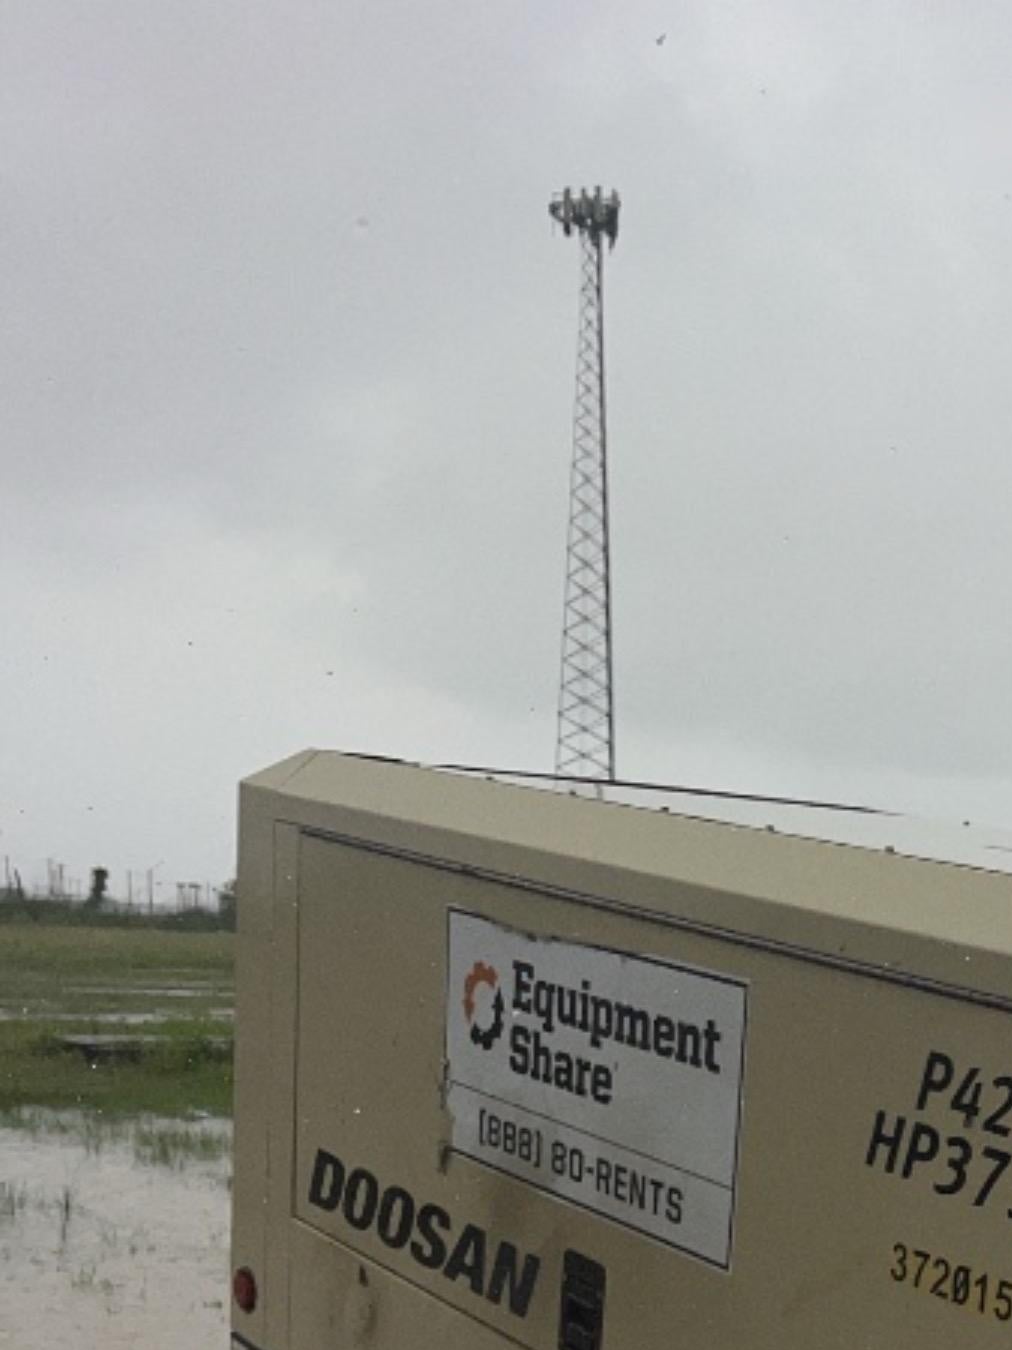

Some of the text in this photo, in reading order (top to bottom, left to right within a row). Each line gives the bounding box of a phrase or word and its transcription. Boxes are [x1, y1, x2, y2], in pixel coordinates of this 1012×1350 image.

[509, 1024, 613, 1105] Share
[513, 960, 720, 1074] Equipment
[479, 1107, 684, 1225] (888) 80-RENTS
[308, 1148, 541, 1319] DOOSAN
